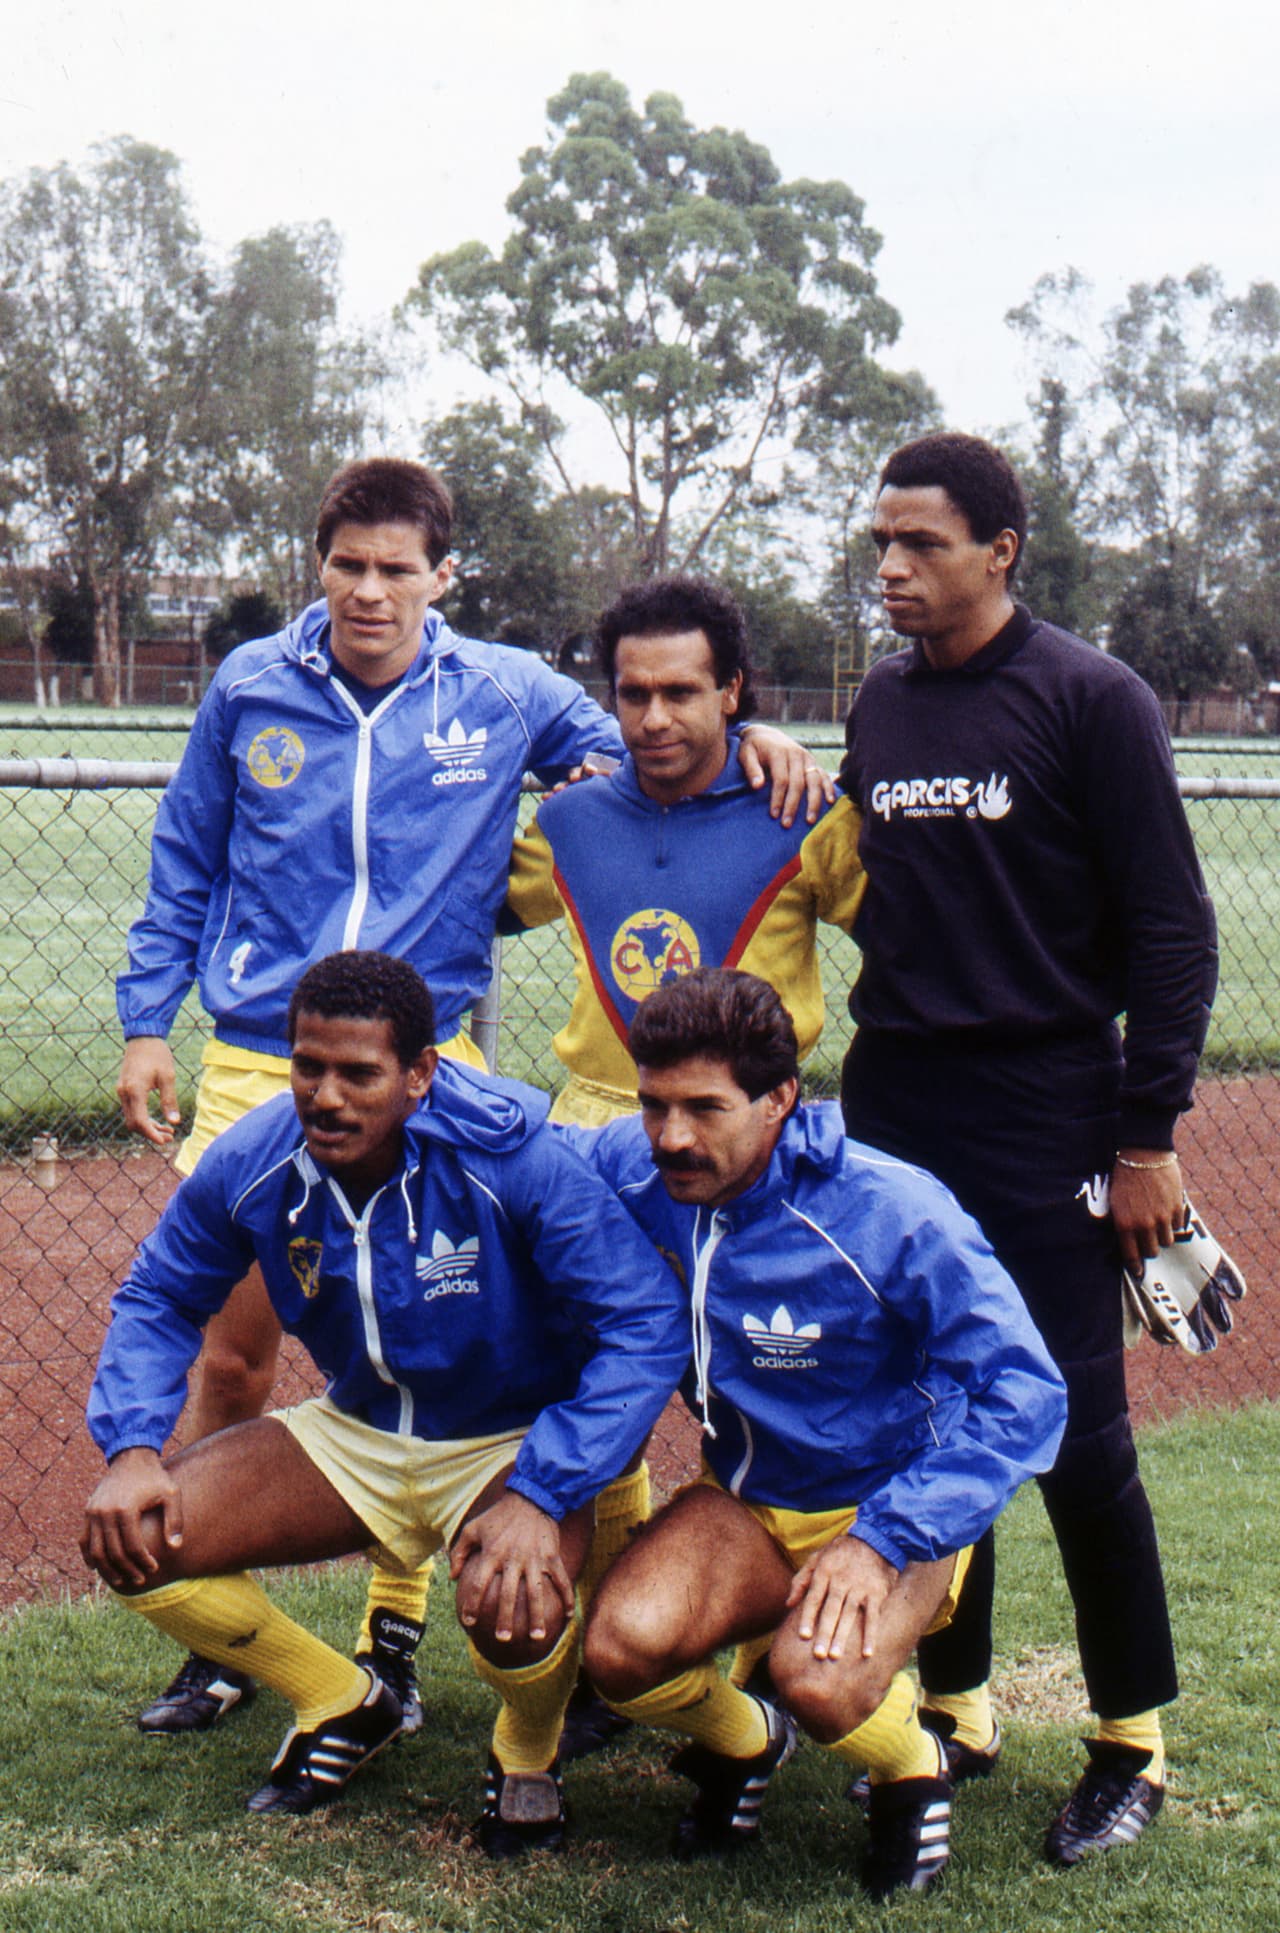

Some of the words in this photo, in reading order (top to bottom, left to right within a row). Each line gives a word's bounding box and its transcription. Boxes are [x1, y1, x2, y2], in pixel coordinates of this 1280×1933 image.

[432, 768, 487, 786] adidas
[872, 777, 971, 821] GARCIS
[615, 942, 641, 975] C
[666, 938, 694, 972] A
[423, 1278, 480, 1301] adidas
